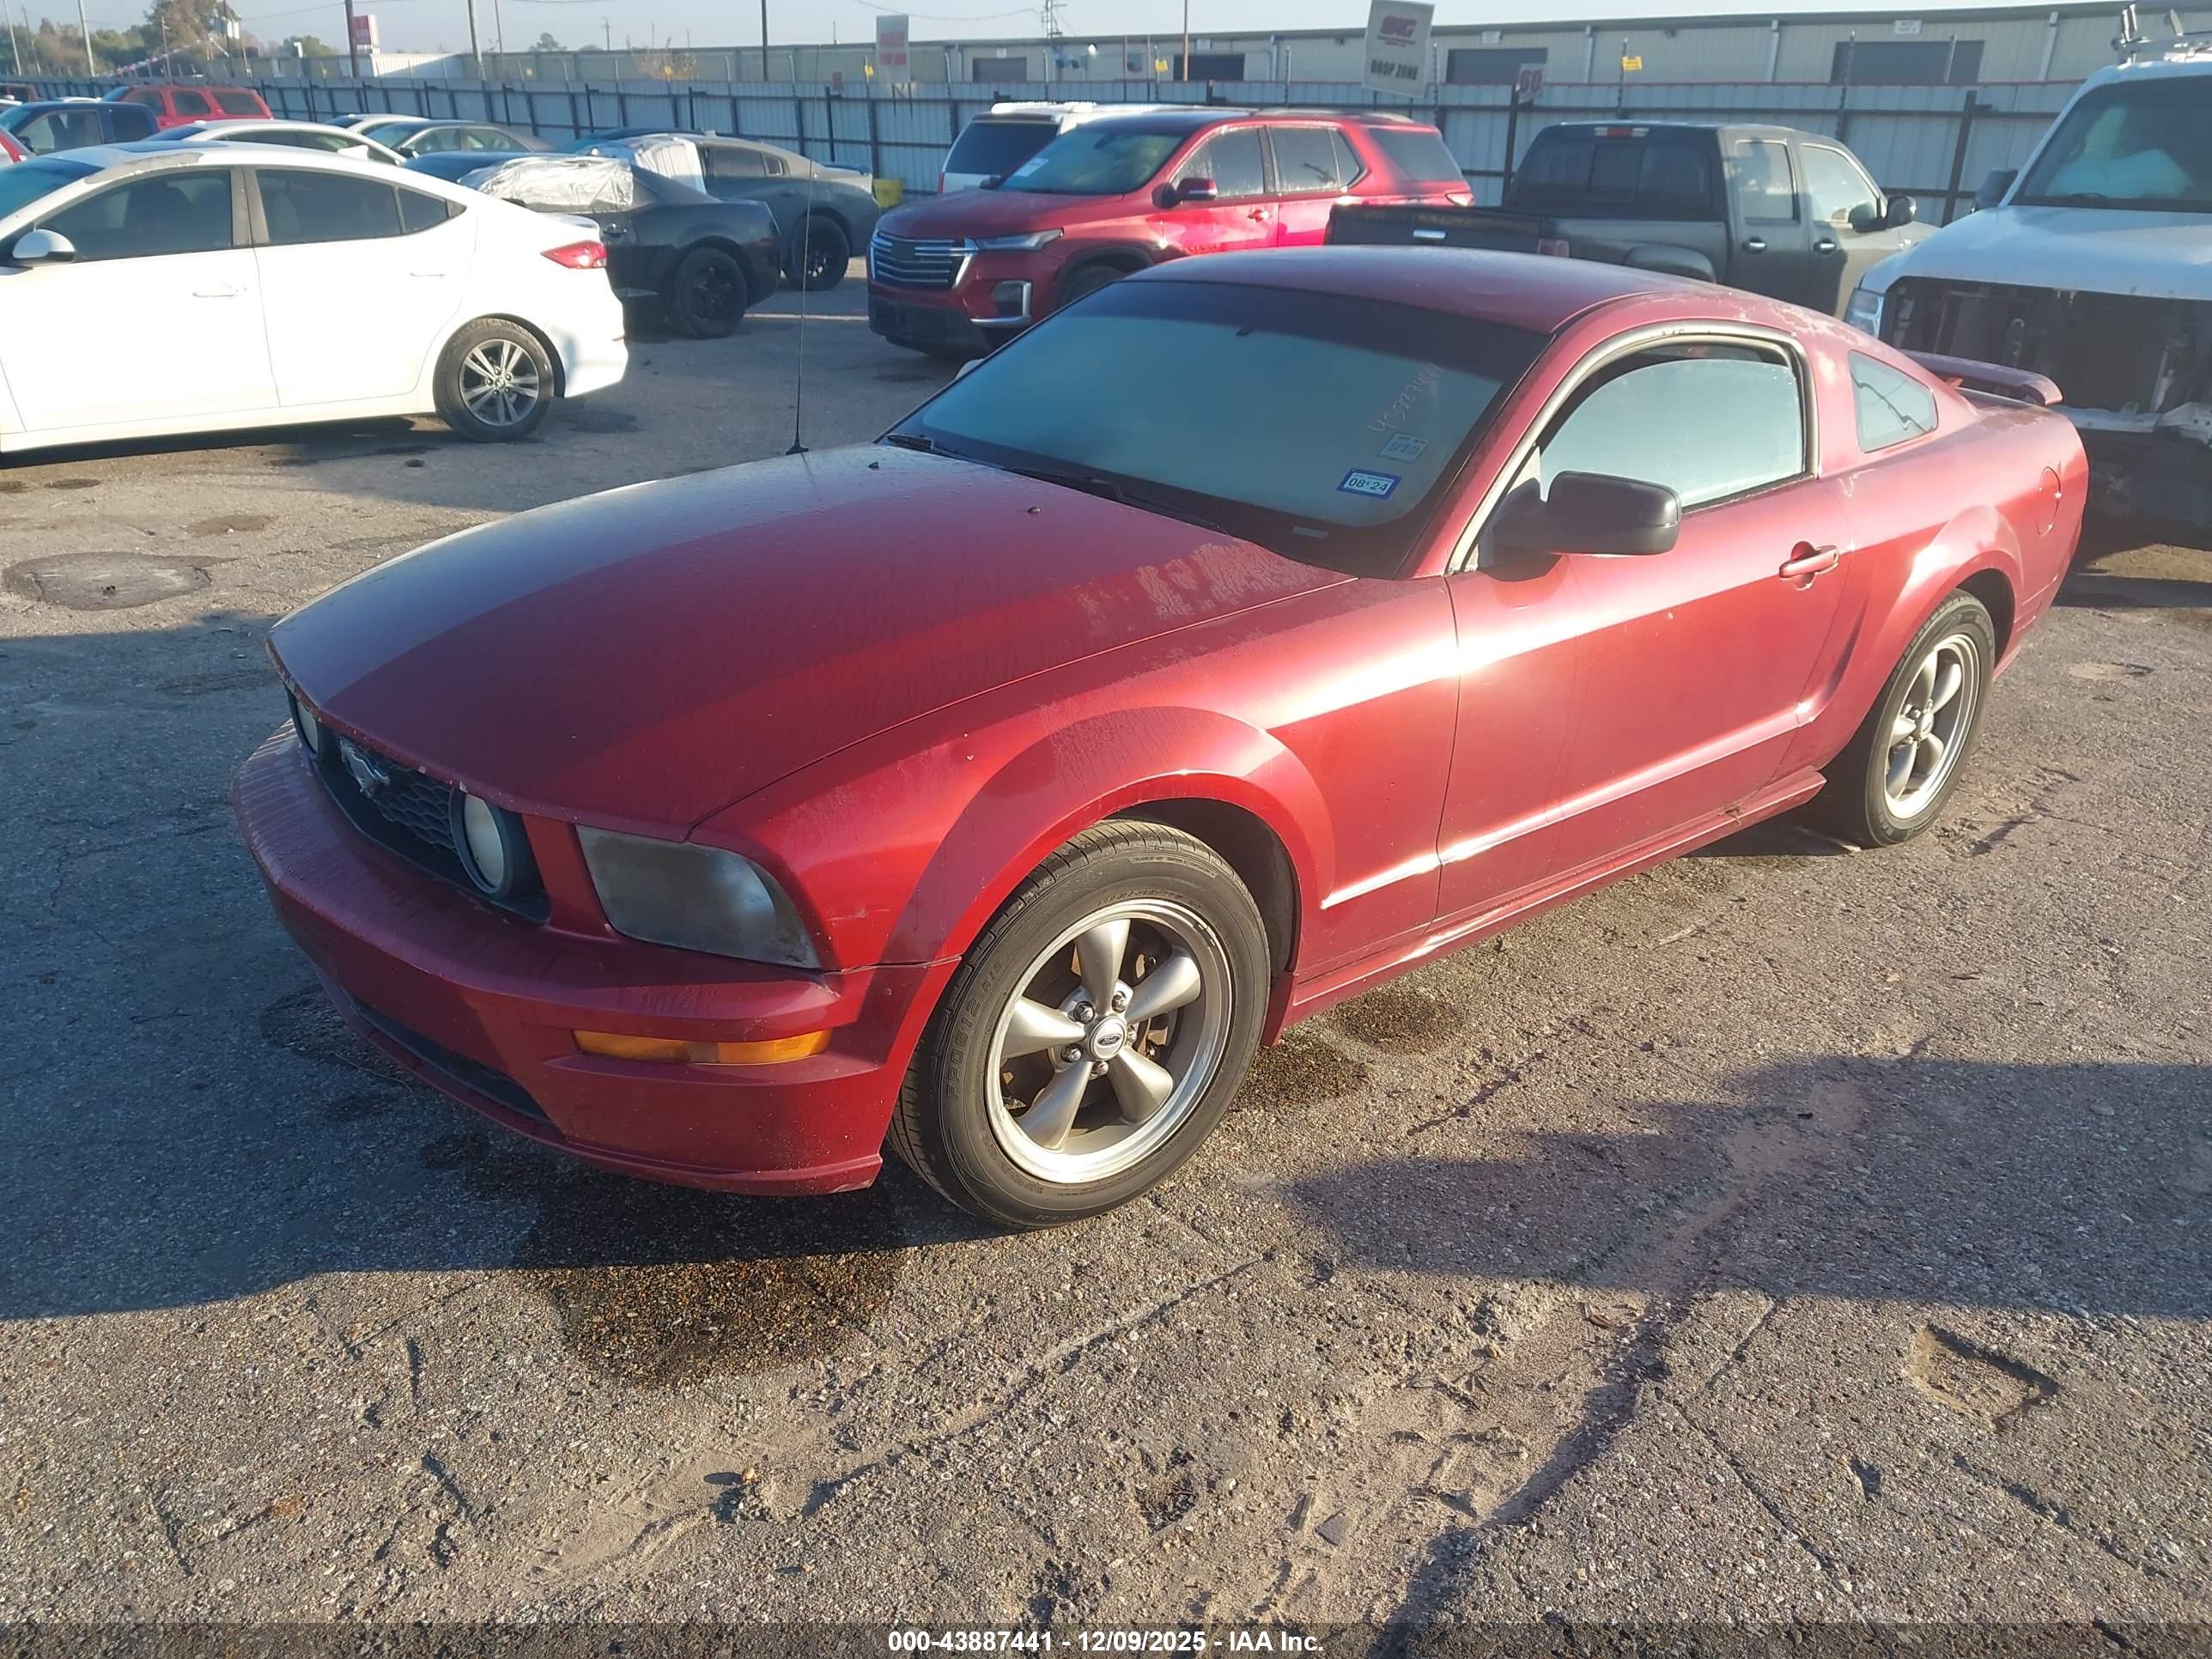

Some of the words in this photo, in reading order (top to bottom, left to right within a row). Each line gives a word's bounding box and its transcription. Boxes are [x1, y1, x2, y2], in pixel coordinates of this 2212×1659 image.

[1370, 59, 1395, 76] DROP
[1395, 64, 1419, 81] ZONE
[1348, 477, 1365, 488] 08
[1370, 481, 1389, 491] 24
